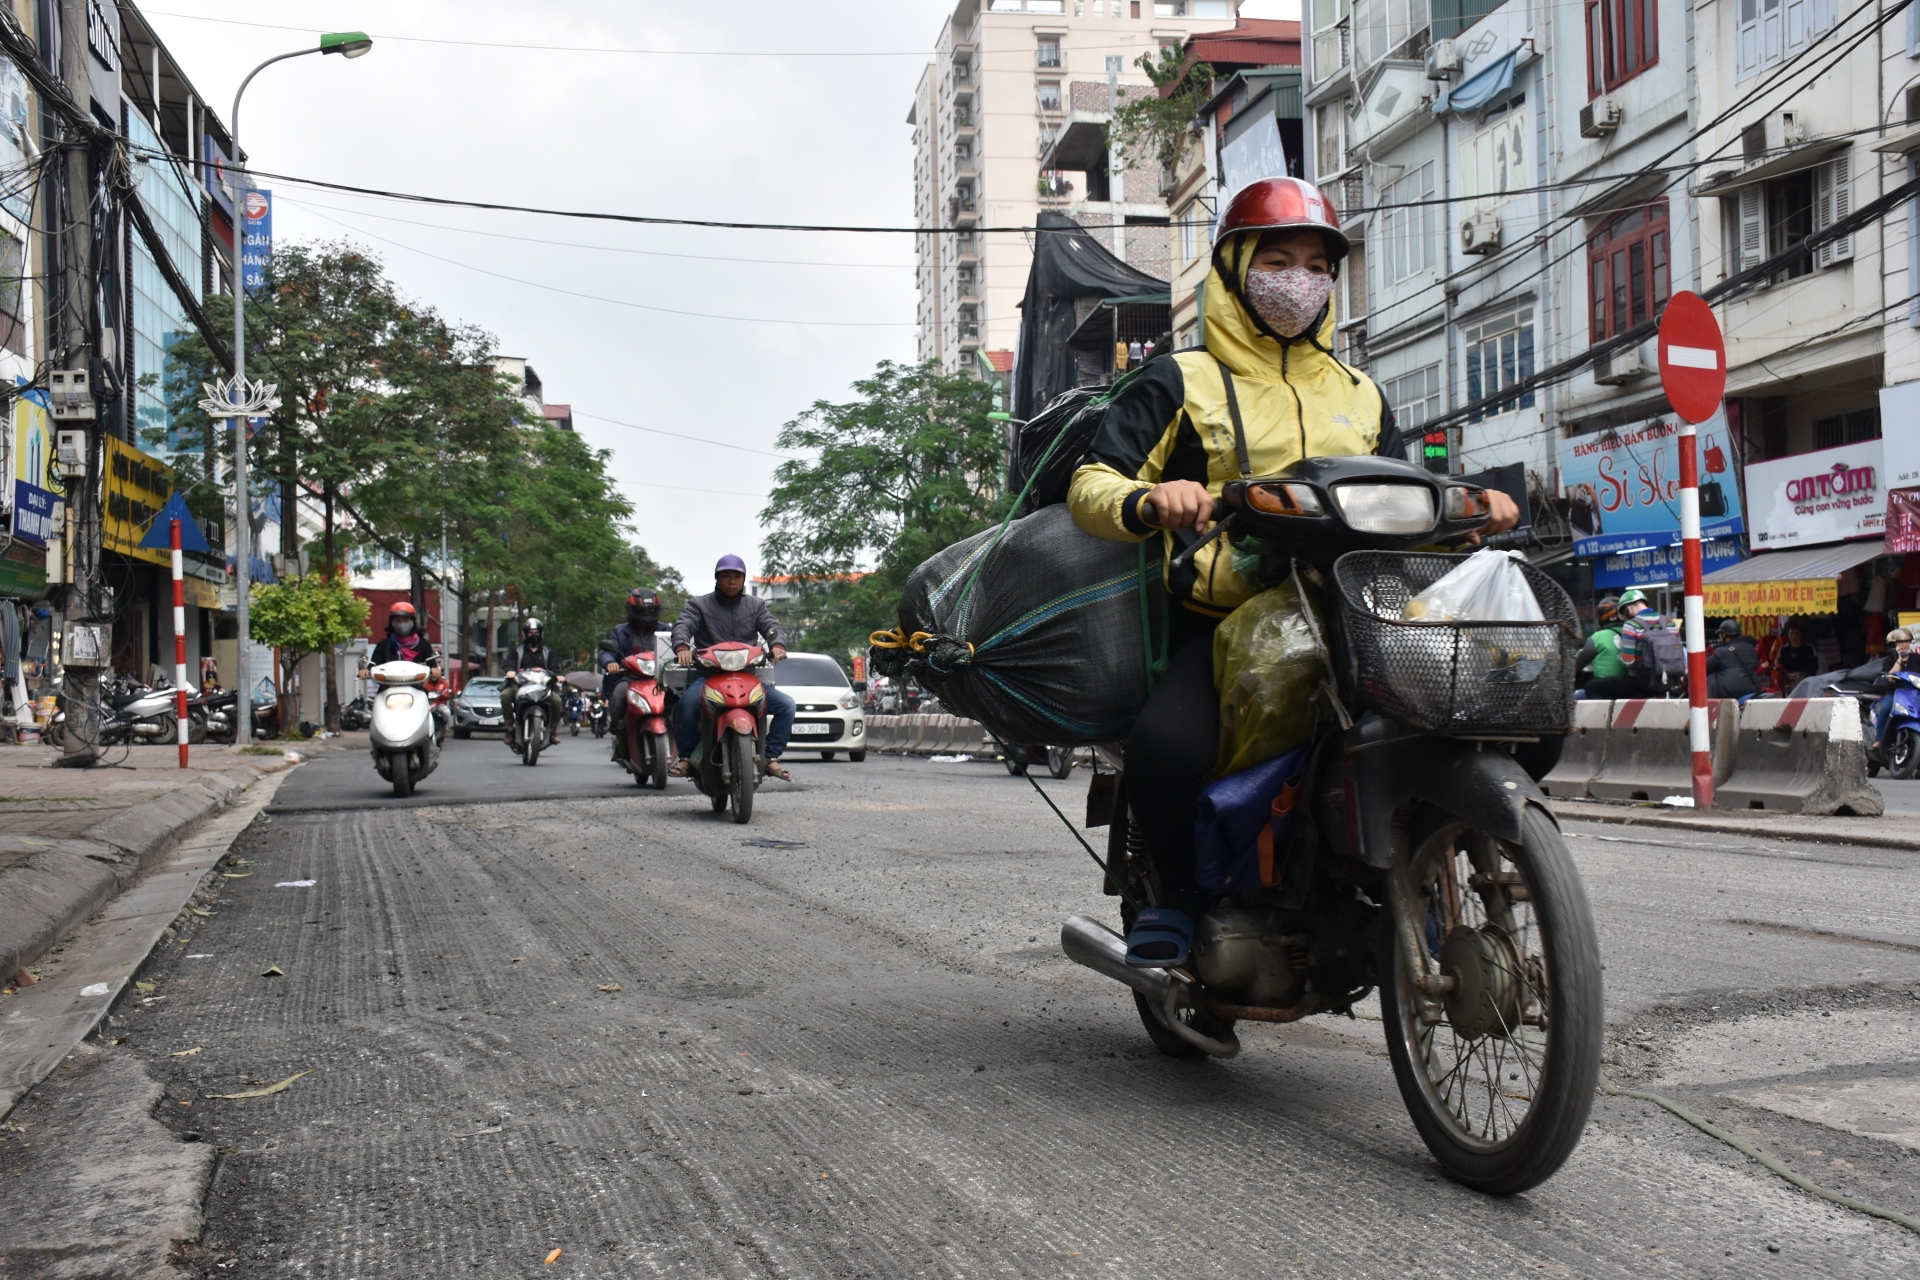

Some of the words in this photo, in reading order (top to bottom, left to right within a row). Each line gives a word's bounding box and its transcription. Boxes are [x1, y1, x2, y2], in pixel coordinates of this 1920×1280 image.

[1573, 441, 1599, 457] HÀNG
[1598, 455, 1634, 512] Si
[1638, 447, 1682, 506] Sho
[1795, 504, 1815, 516] Cùng
[1816, 502, 1831, 512] con
[1831, 498, 1851, 510] vững
[18, 507, 40, 536] THANH
[1758, 532, 1768, 541] 120
[1587, 541, 1599, 554] 122
[1669, 547, 1684, 565] QU
[1800, 587, 1814, 602] EM
